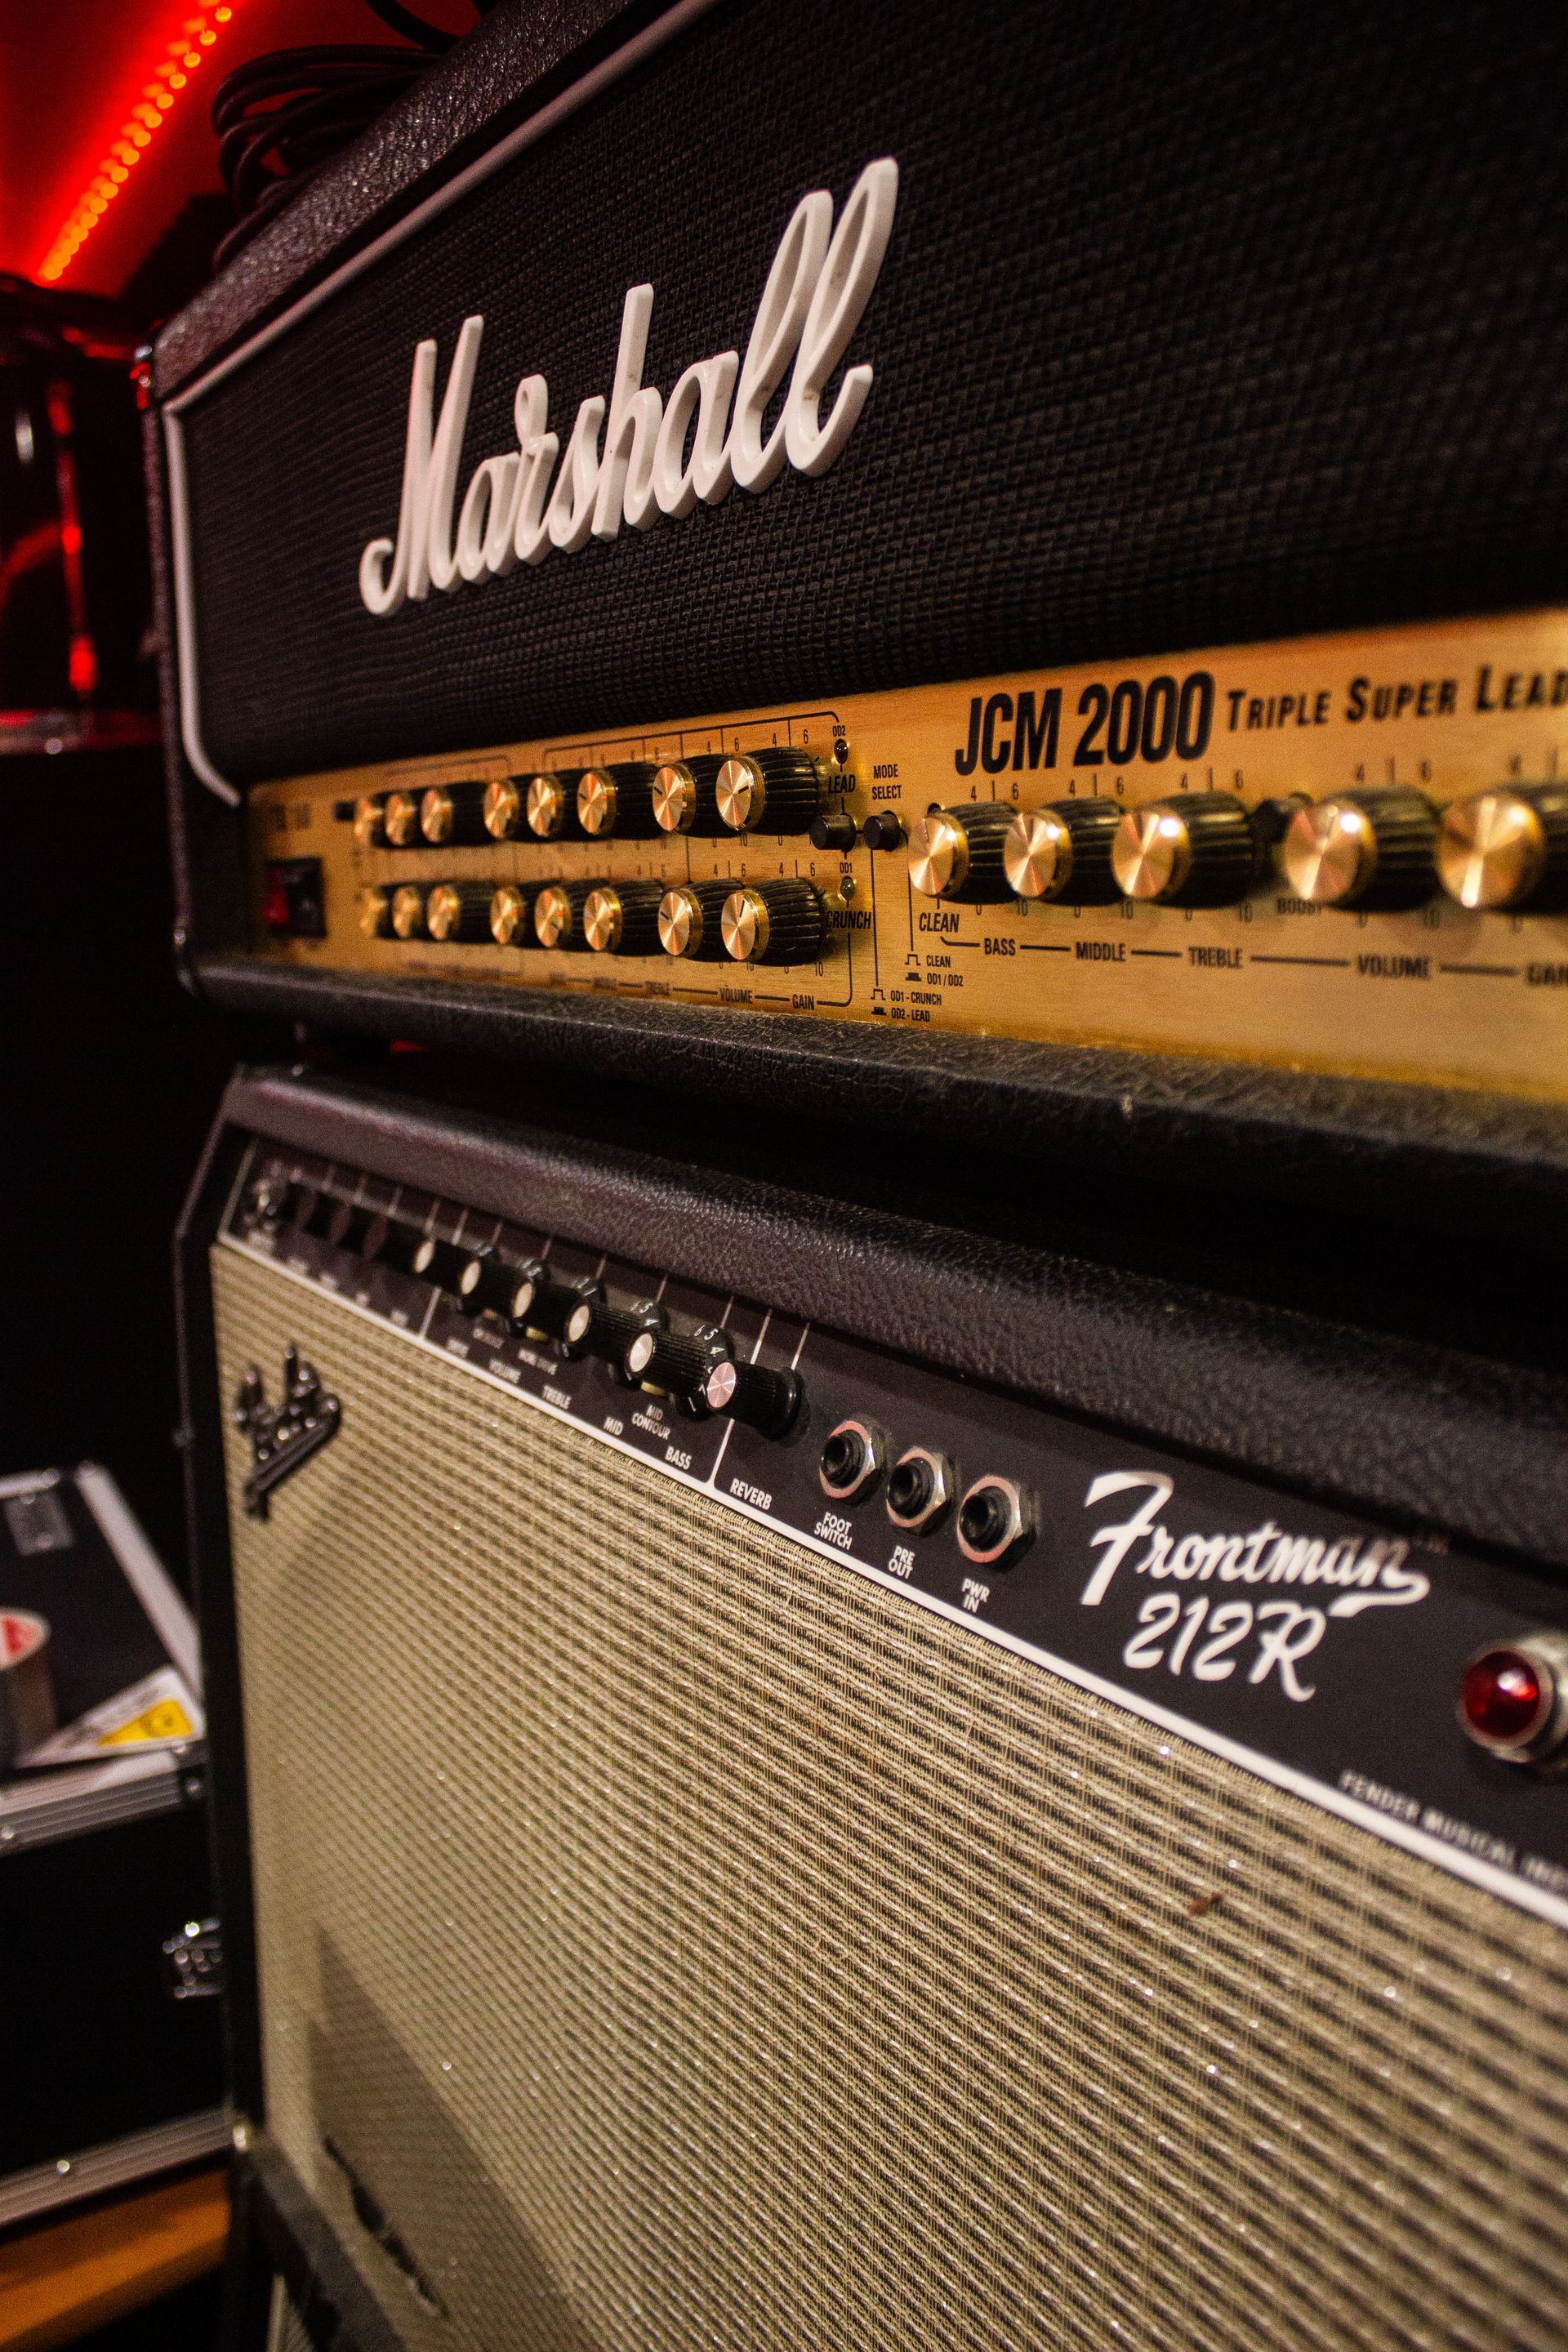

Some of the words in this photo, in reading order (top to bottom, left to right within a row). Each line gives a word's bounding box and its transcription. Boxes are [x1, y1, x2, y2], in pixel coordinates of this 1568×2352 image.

[359, 156, 898, 616] Marshall
[832, 725, 846, 737] OD2
[954, 688, 1063, 776] JCM
[1072, 670, 1217, 767] 2000
[873, 764, 899, 780] MODE
[827, 774, 857, 795] LEAD
[871, 784, 902, 801] SELECT
[840, 862, 853, 874] OD1
[825, 911, 872, 930] CRUNCH
[919, 912, 960, 933] CLEAN
[926, 955, 951, 968] CLEAN
[984, 938, 1017, 956] BASS
[1075, 941, 1127, 962] MIDDLE
[1188, 946, 1244, 969] TREBLE
[719, 987, 752, 1004] VOLUME
[792, 993, 815, 1010] GAIN
[911, 991, 942, 1005] CRUNCH
[911, 1009, 930, 1022] LEAD
[542, 1384, 572, 1410] TREBLE
[646, 1404, 664, 1421] MID
[603, 1416, 624, 1437] MID
[631, 1411, 671, 1441] CONTOUR
[664, 1445, 693, 1471] BASS
[729, 1477, 773, 1511] REVERB
[822, 1511, 852, 1535] FOOT
[813, 1521, 853, 1551] SWITCH
[1080, 1469, 1431, 1619] Frontman
[893, 1544, 915, 1566] PRE
[888, 1559, 914, 1580] OUT
[960, 1577, 991, 1604] PWR
[963, 1593, 982, 1614] IN
[1122, 1591, 1328, 1703] 212R
